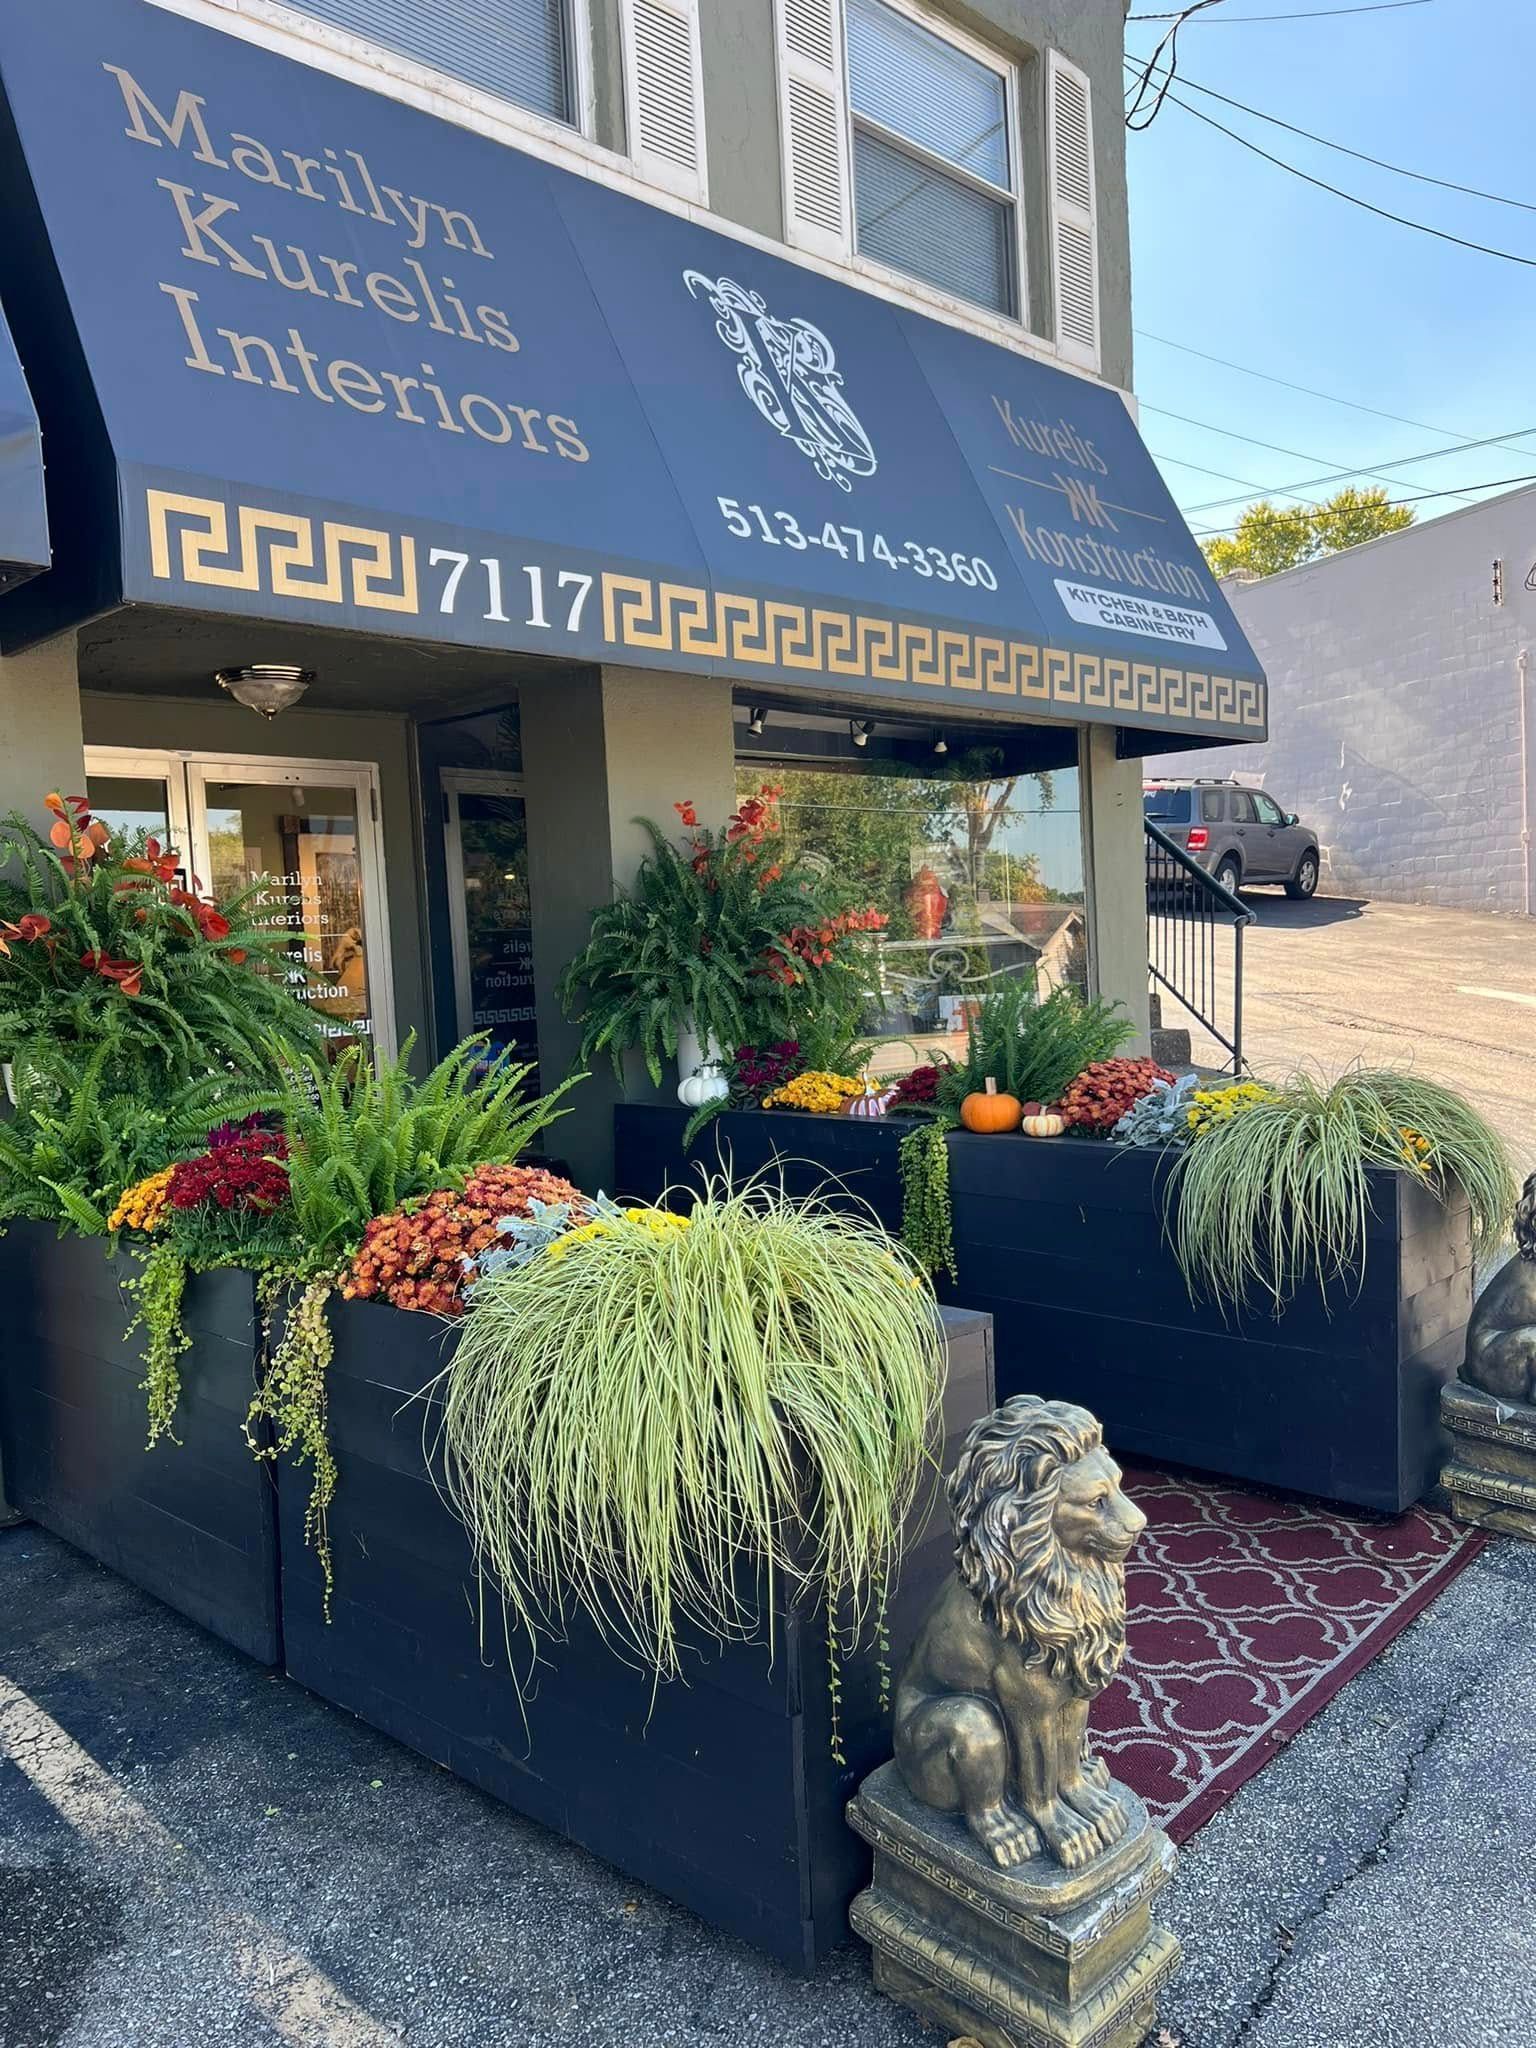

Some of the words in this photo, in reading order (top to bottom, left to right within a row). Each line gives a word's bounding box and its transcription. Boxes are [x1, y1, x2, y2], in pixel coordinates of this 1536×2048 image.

[102, 62, 495, 259] Marilyn
[156, 177, 520, 352] Kurelis
[158, 281, 590, 463] Interiors
[991, 394, 1109, 476] Kurelis
[428, 547, 594, 633] 7117
[716, 496, 998, 591] 513-474-3360
[1004, 503, 1211, 603] Konstruction
[1066, 585, 1151, 617] KITCHEN
[1151, 606, 1164, 620] &
[1166, 608, 1209, 630] BATH
[1098, 609, 1196, 641] CABINETRY
